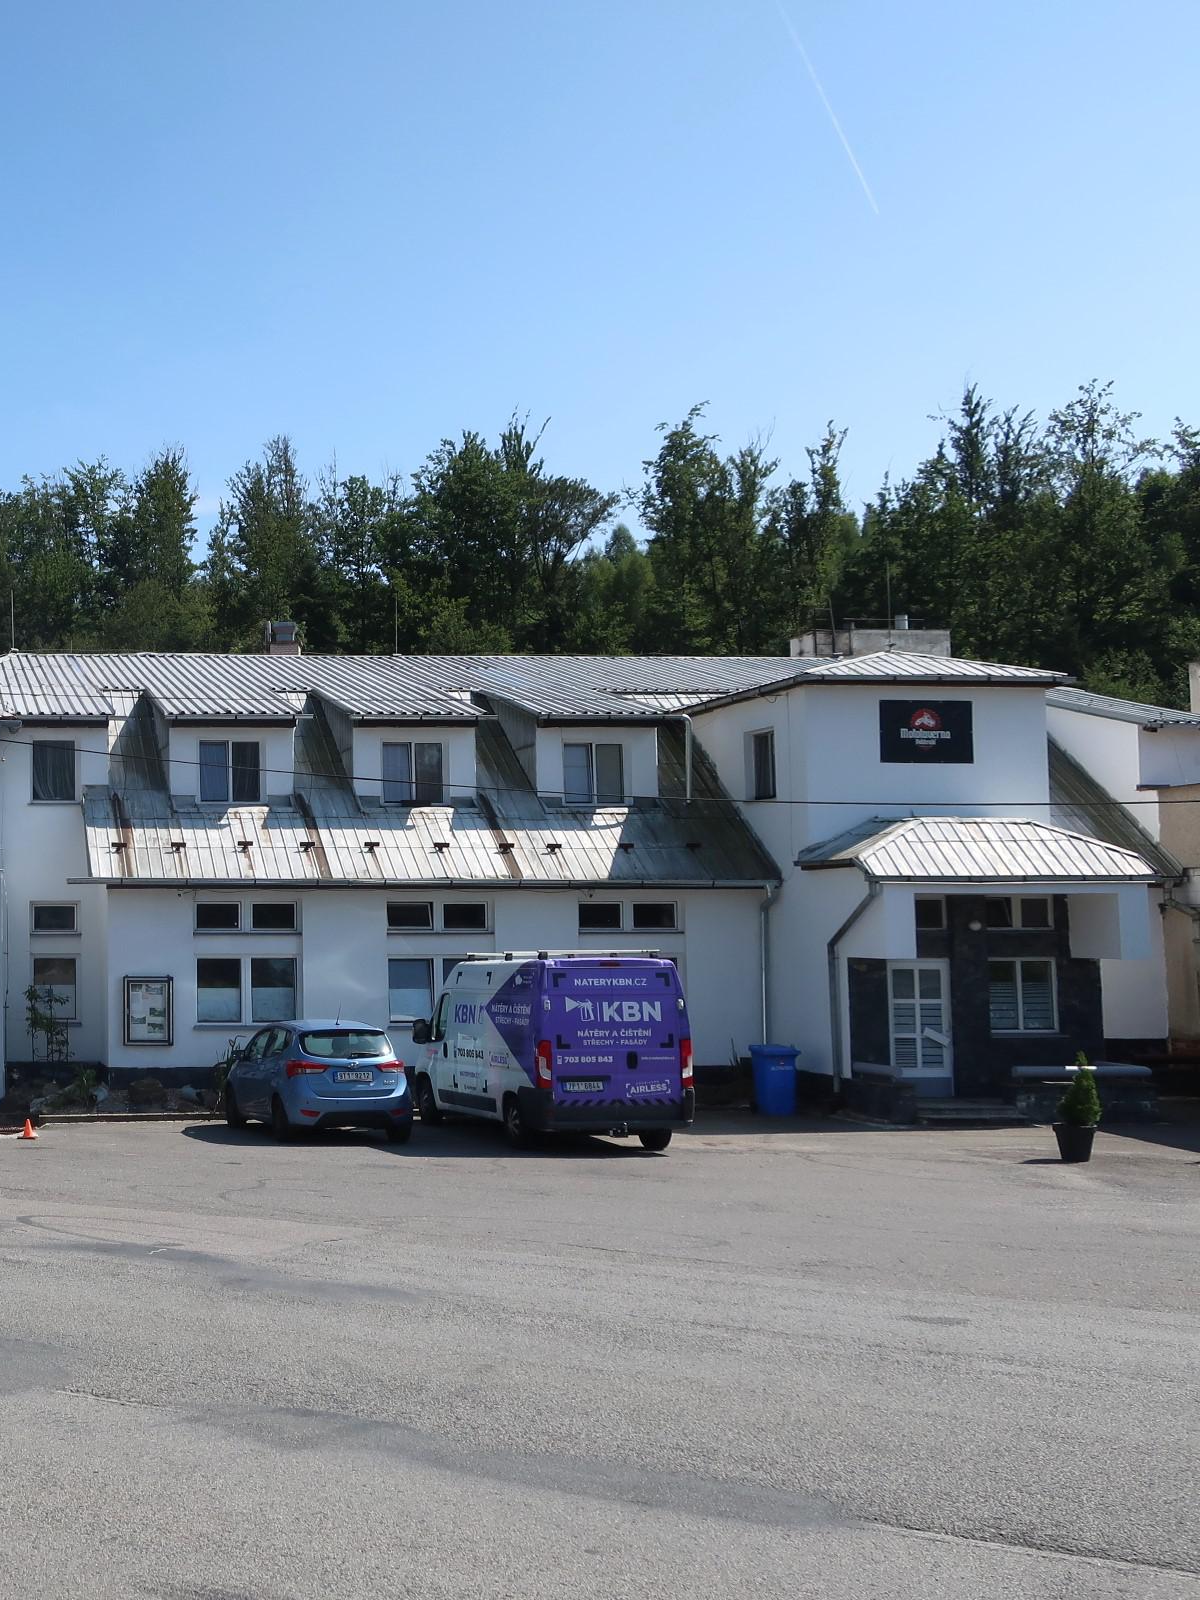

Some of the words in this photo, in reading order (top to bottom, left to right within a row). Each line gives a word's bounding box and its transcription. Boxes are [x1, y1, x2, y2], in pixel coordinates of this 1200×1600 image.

[574, 978, 647, 987] NATERYKBN.CZ
[454, 1004, 476, 1024] KBN
[603, 1001, 662, 1022] KBN
[577, 1029, 609, 1037] NÁTĚRY
[620, 1027, 652, 1037] ČIŠTĚNÍ
[583, 1037, 614, 1046] STŘECHY
[620, 1037, 648, 1046] FASÁDY
[564, 1056, 579, 1064] 703
[630, 1083, 667, 1094] AIRLESS
